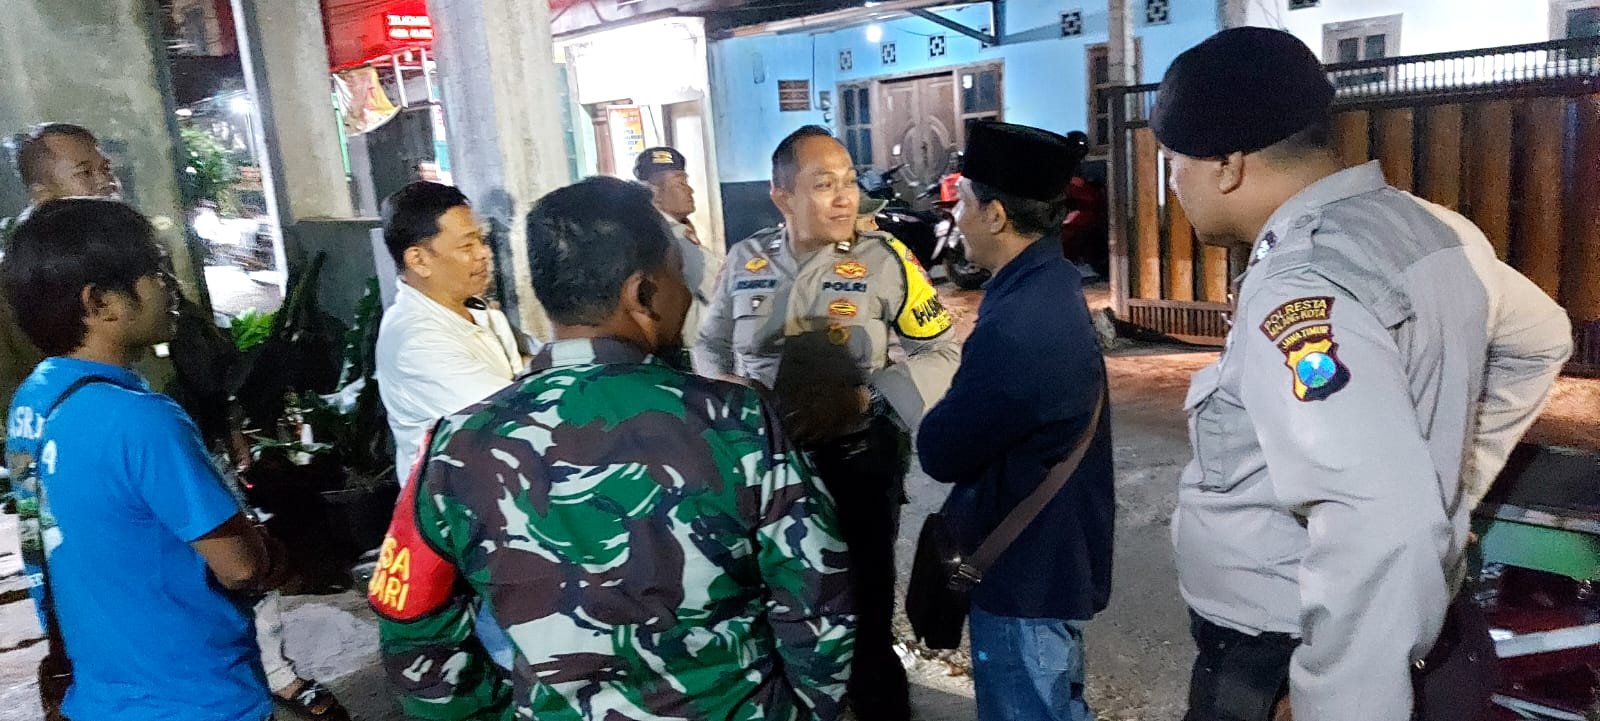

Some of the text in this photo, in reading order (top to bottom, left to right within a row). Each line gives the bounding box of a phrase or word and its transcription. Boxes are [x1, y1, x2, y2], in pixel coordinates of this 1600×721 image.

[822, 281, 868, 293] POLRI
[1263, 299, 1328, 332] POLRESTA
[1300, 307, 1327, 320] KOTA
[1281, 324, 1331, 349] JAWA TIMUR
